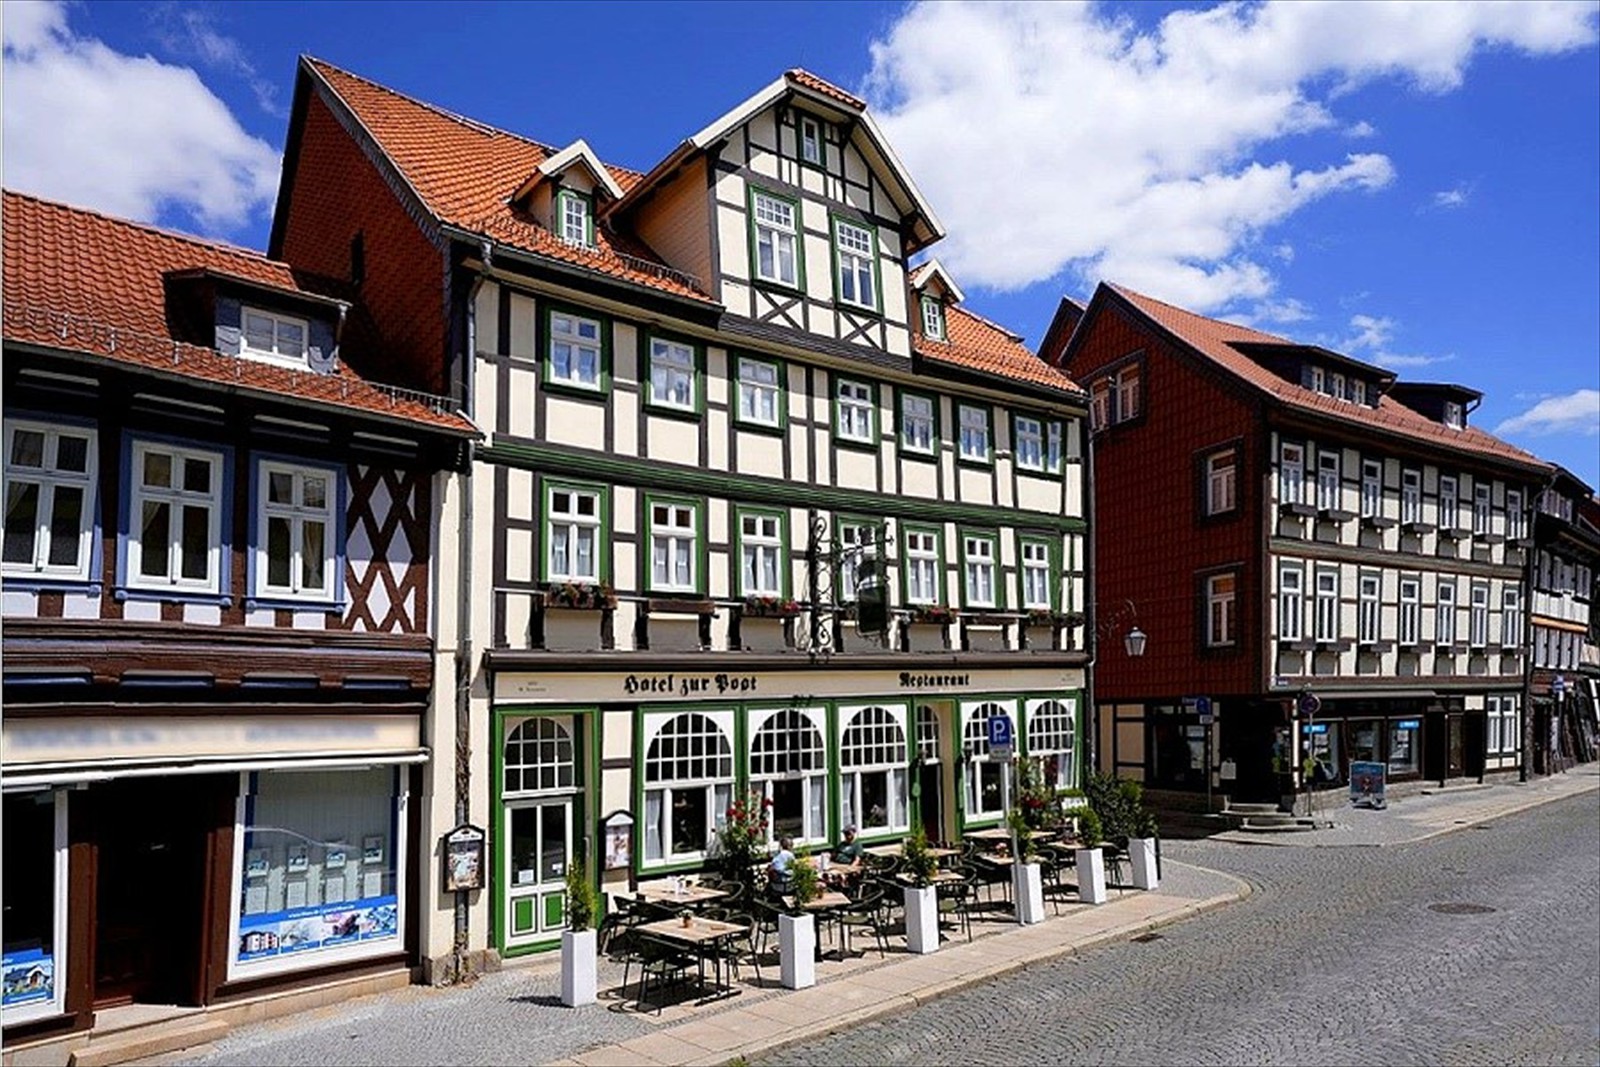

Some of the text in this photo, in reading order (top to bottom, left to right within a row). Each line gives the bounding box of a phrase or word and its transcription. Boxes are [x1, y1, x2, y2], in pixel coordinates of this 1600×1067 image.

[624, 674, 757, 697] Hotel zur Post
[899, 672, 969, 688] Restaurant
[993, 720, 1006, 742] P
